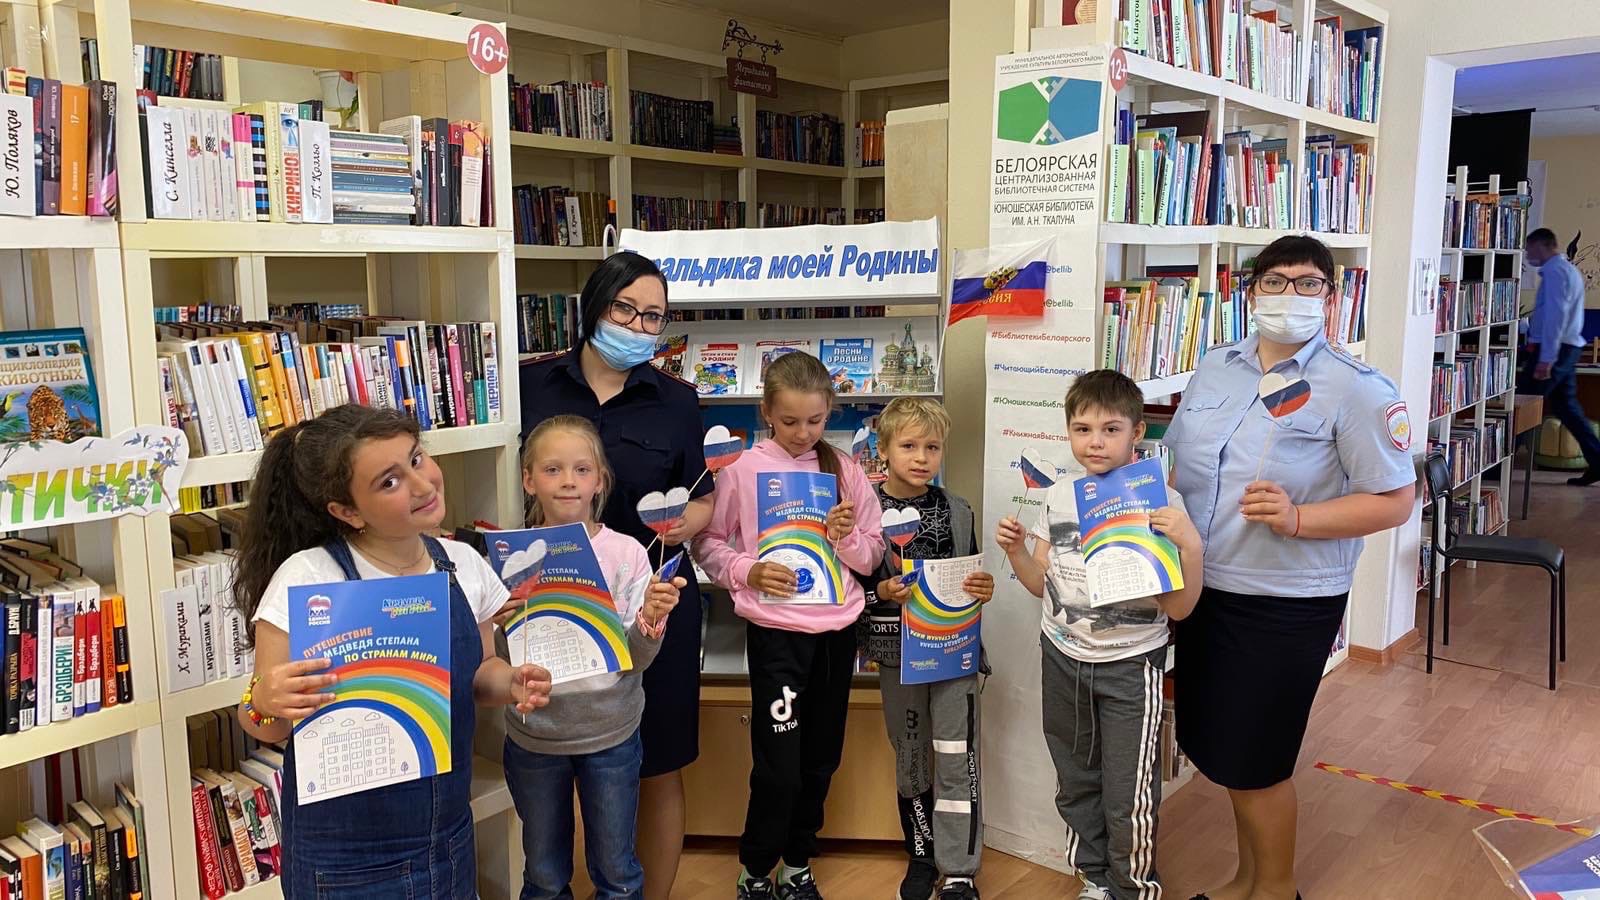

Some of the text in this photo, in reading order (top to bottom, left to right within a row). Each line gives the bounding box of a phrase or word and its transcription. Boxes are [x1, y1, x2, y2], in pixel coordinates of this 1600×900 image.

[469, 31, 508, 63] 16+
[1111, 57, 1127, 76] 12+
[5, 109, 22, 198] Ю. Поляков
[163, 122, 178, 202] С. Кинселла
[996, 153, 1097, 174] БЕЛОЯРСКАЯ
[311, 143, 322, 199] П. Коэльо
[995, 171, 1096, 186] ЦЕНТРАЛИЗОВАННАЯ
[283, 156, 301, 215] КИРИНО
[995, 183, 1095, 195] БИБЛИОТЕЧНАЯ СИСТЕМА
[994, 200, 1094, 214] ЮНОШЕСКАЯ БИБЛИОТЕКА
[1012, 216, 1026, 226] ИМ.
[1043, 215, 1075, 225] ТКАЛУНА
[654, 245, 938, 287] альдика моей Родины
[1043, 299, 1074, 308] @bellib
[992, 331, 1091, 344] #БиблиотекиБелоярского
[0, 358, 81, 373] ЦИКЛОПЕДИЯ
[487, 368, 499, 409] МЕРДОК
[993, 397, 1065, 409] #ЮношескаяБибли
[5, 459, 164, 524] ТИЧКИ
[541, 576, 597, 587] СТРАНАМ МИРА
[547, 568, 579, 576] СТЕПАНА
[177, 601, 189, 655] Мураками
[232, 616, 242, 665] мураками
[205, 622, 214, 671] мураками
[304, 626, 373, 658] ПУТЕШЕСТВИЕ
[323, 636, 420, 659] МЕДВЕДЯ СТЕПАНА
[105, 640, 114, 678] БРЭДБЕРИ
[344, 649, 438, 664] ПО СТРАНАМ МИРА
[55, 648, 73, 703] БРЭДБЕРИ
[235, 826, 256, 874] САРАМАГО
[1583, 859, 1600, 878] РОСС
